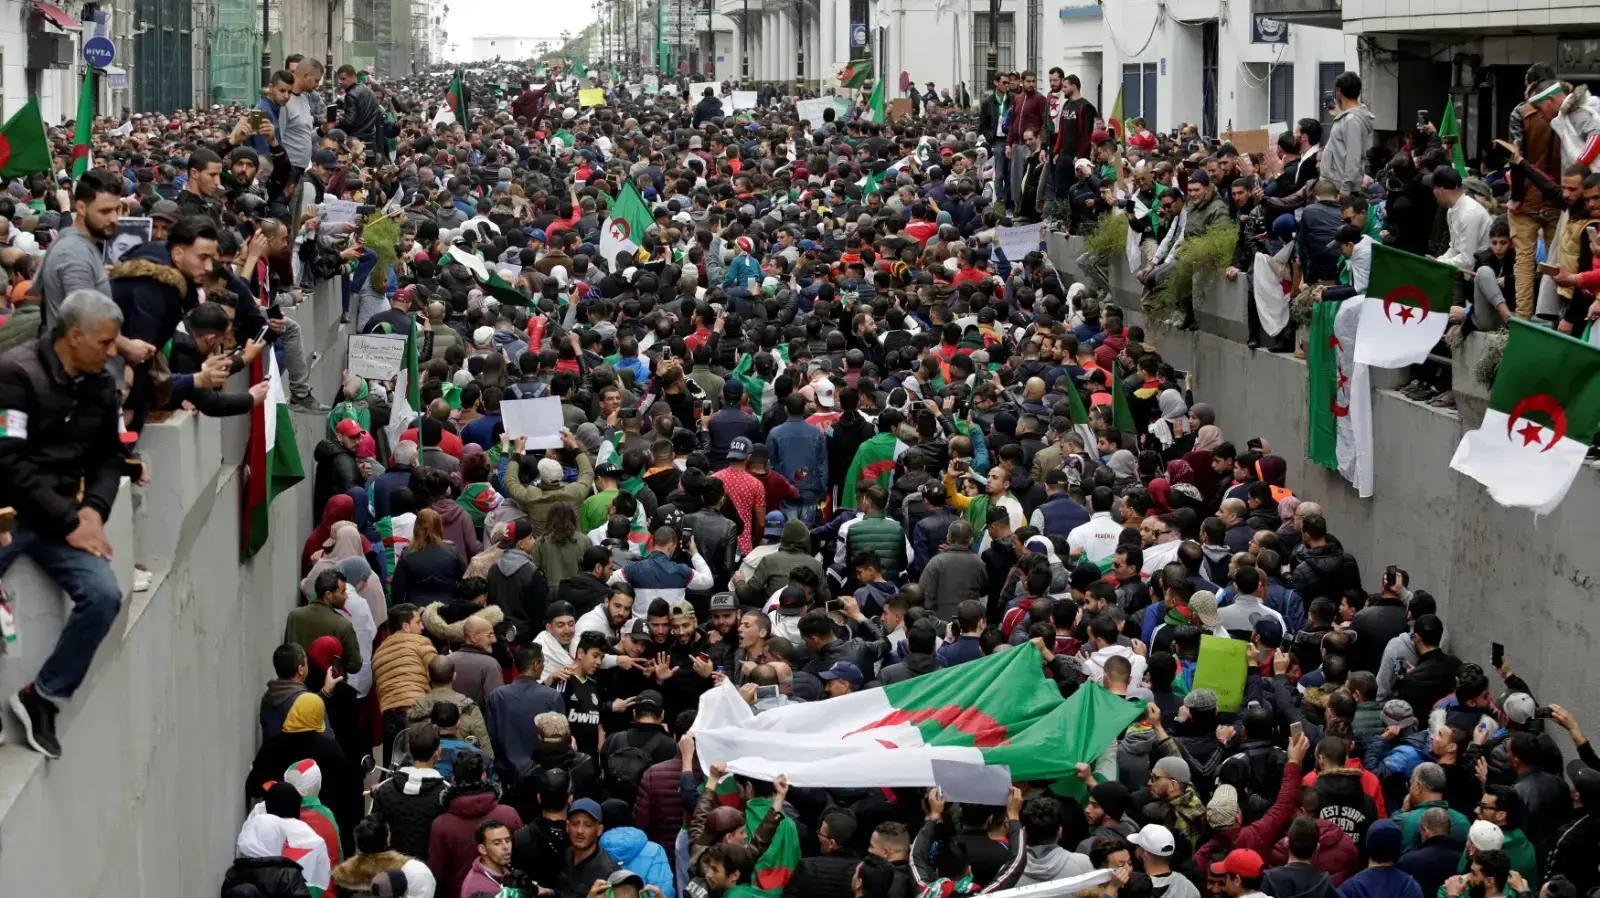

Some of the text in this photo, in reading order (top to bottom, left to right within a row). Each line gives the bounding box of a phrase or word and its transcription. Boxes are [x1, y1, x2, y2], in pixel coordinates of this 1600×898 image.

[86, 48, 111, 57] NIVEA
[568, 708, 600, 725] bwin
[1341, 806, 1367, 823] SURF
